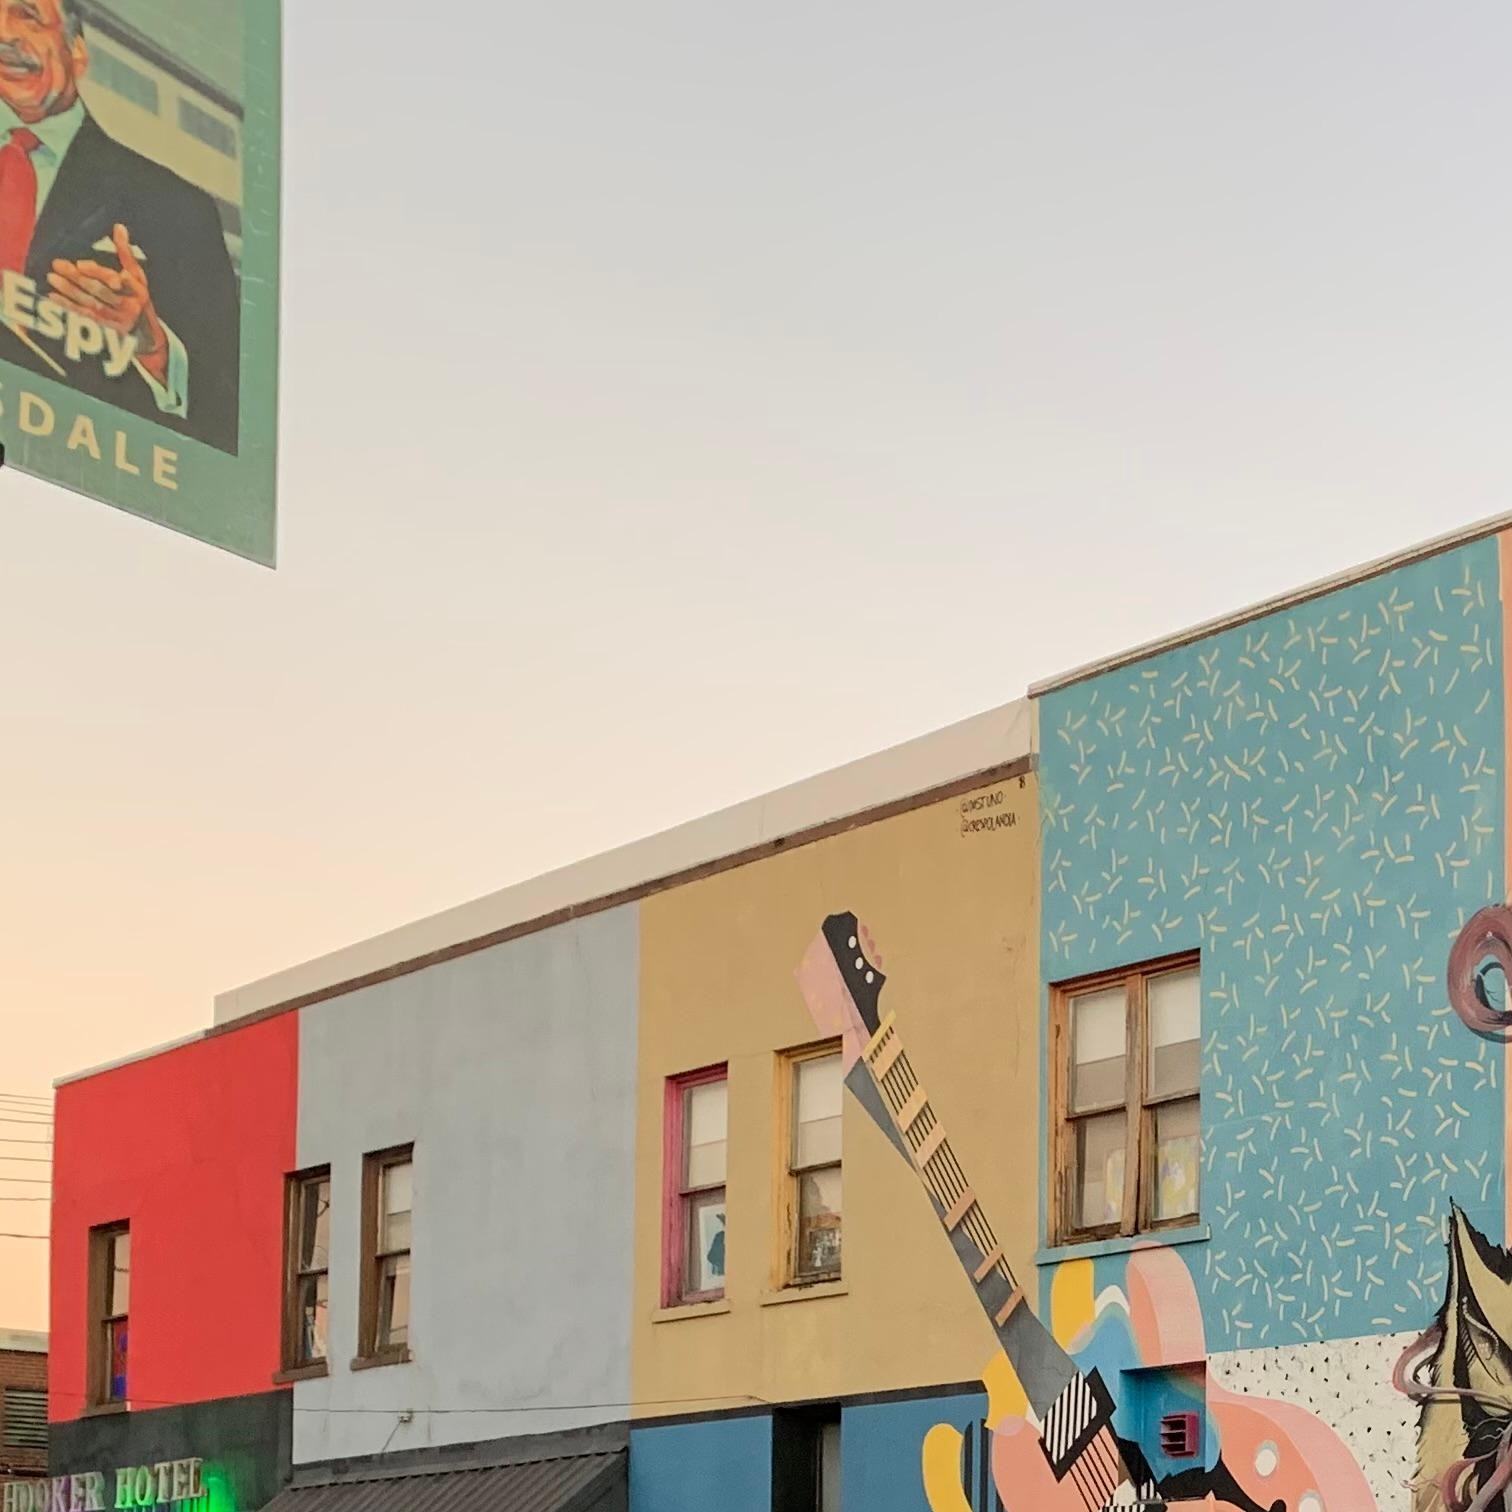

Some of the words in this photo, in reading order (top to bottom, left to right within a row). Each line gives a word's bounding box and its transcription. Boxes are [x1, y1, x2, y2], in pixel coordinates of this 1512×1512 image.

[1, 269, 138, 377] Espy
[0, 381, 178, 490] DALE
[114, 1457, 207, 1508] HOTEL
